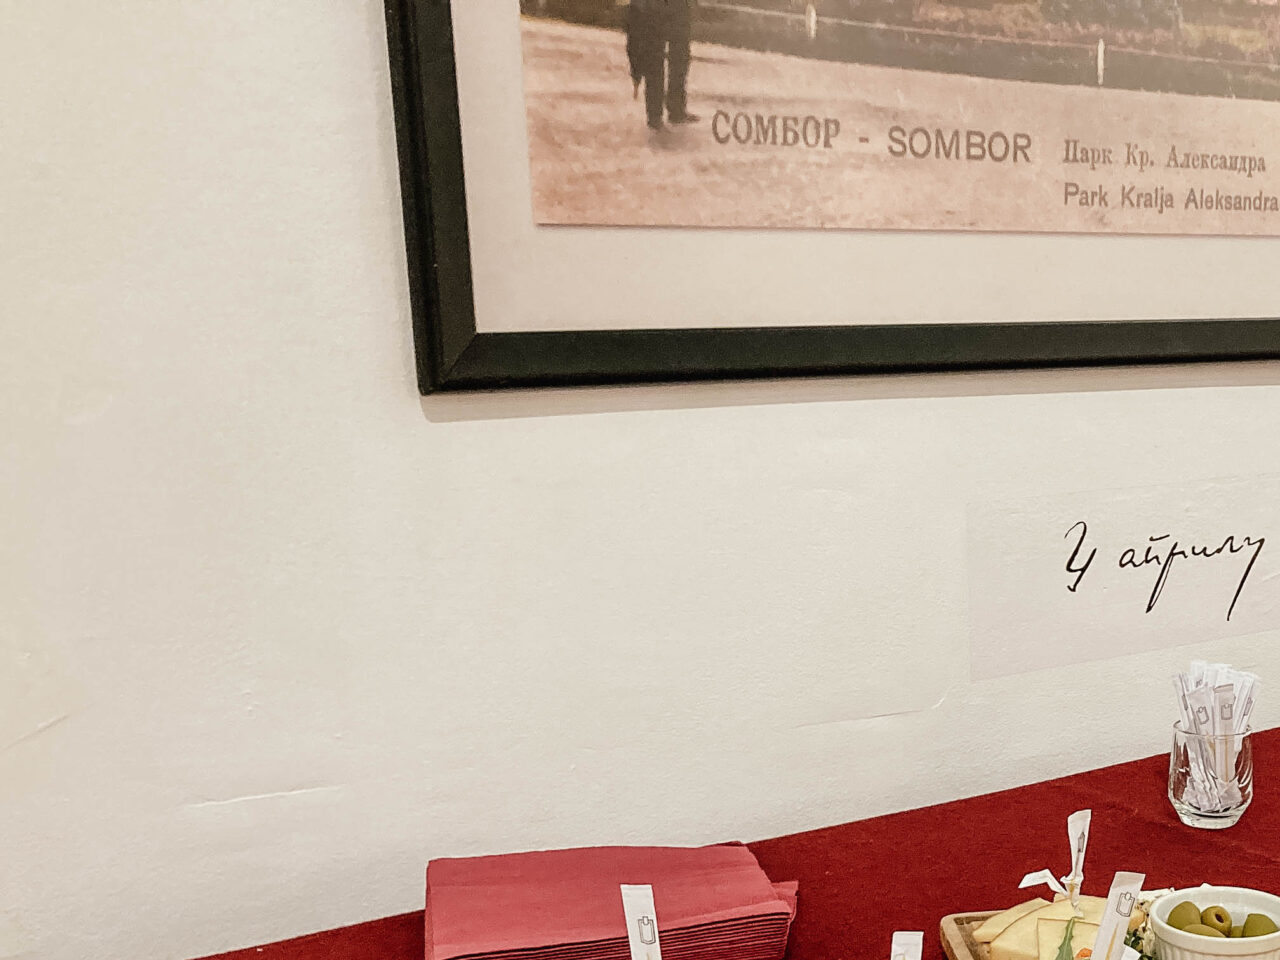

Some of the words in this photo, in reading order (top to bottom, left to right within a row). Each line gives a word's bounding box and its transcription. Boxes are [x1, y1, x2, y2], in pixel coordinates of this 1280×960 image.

[711, 110, 841, 149] СОМБОР
[887, 125, 1032, 163] SOMBOR
[1062, 139, 1113, 171] Парк
[1125, 142, 1155, 172] Кр.
[1166, 144, 1266, 178] Александра
[1064, 182, 1109, 208] Park
[1121, 184, 1175, 214] Kralja
[1184, 187, 1280, 212] Aleksandra
